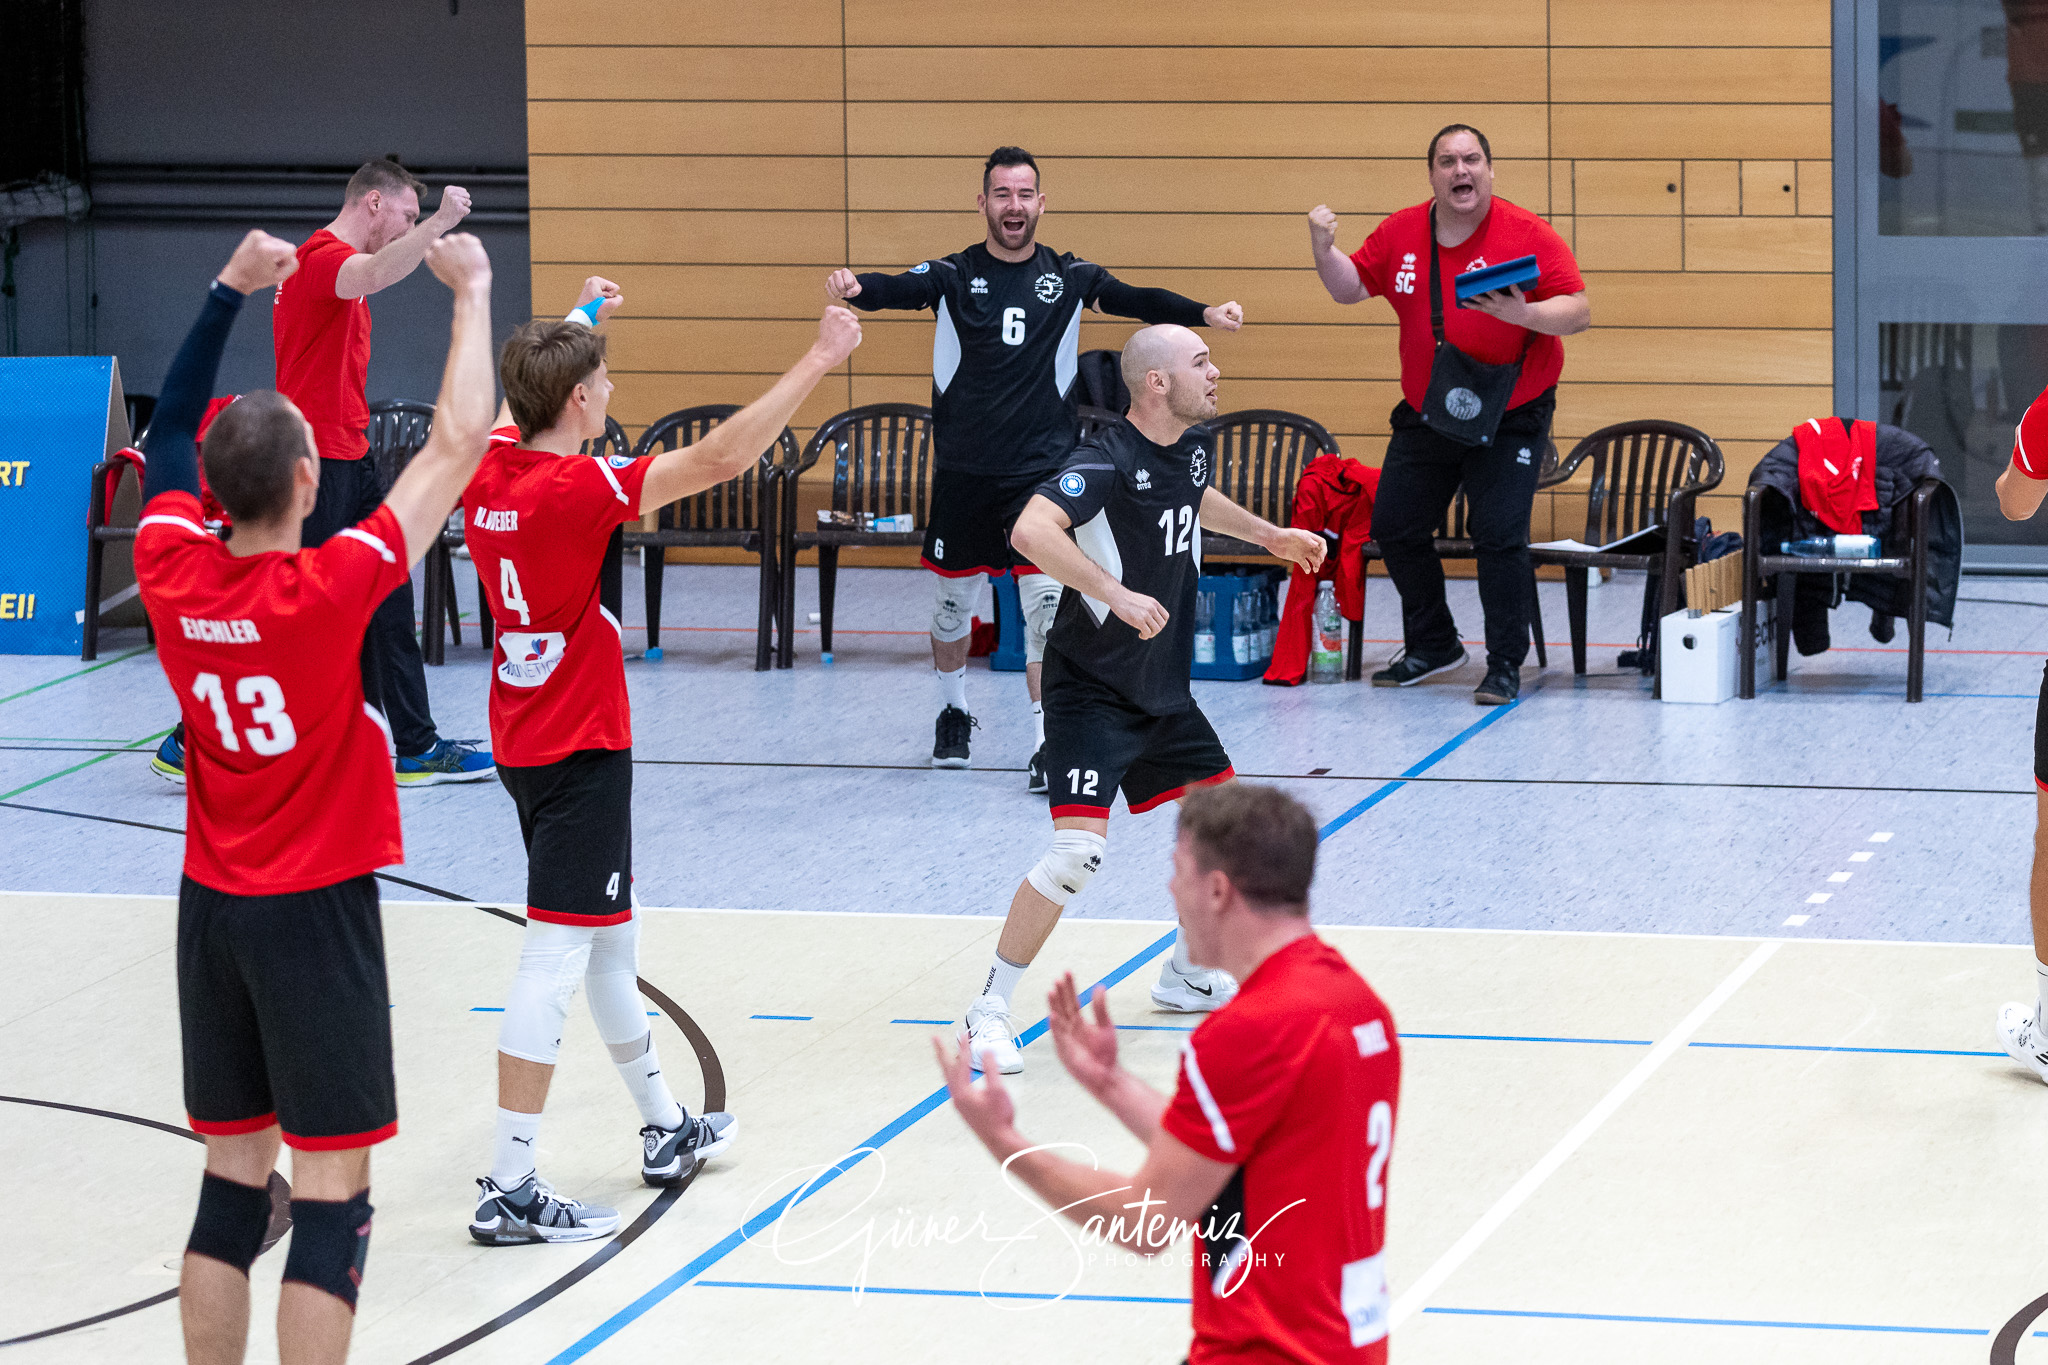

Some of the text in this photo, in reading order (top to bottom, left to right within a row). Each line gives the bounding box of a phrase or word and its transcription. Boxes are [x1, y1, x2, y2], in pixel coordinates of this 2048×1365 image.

[1395, 271, 1416, 294] SC
[1002, 307, 1025, 345] 6
[1158, 504, 1193, 556] 12
[934, 538, 944, 560] 6
[500, 557, 530, 625] 4
[179, 615, 262, 644] EICHLER
[191, 672, 297, 757] 13
[1067, 768, 1099, 796] 12
[606, 872, 620, 900] 4
[1366, 1100, 1392, 1210] 2
